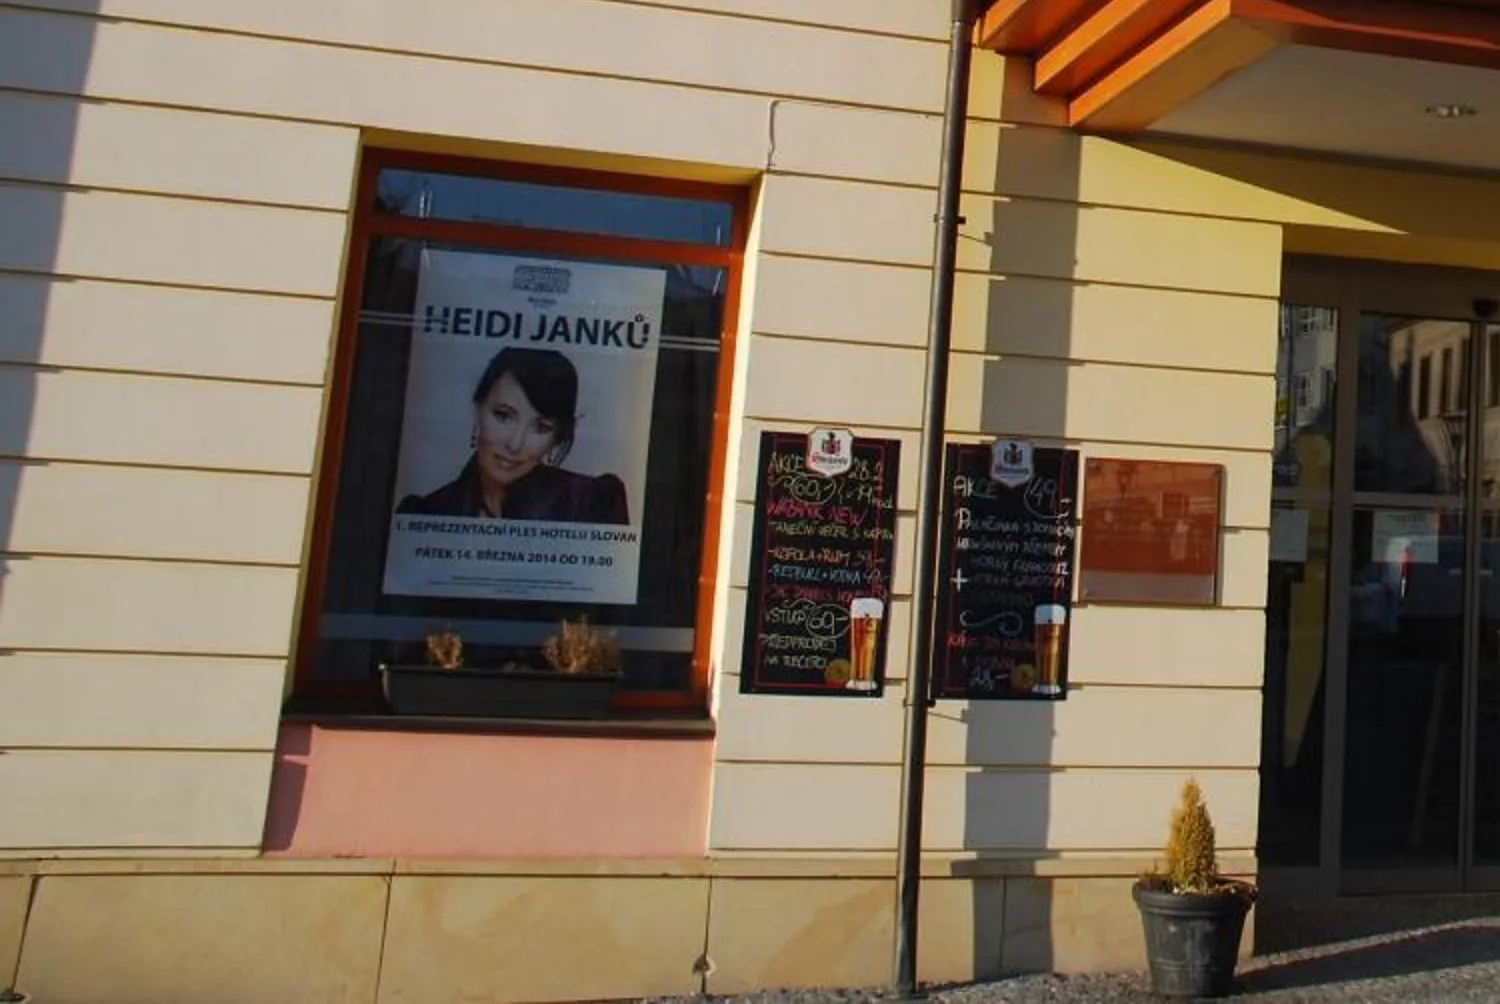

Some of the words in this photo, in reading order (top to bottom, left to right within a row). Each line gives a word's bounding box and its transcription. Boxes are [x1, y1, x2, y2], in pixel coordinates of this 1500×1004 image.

[423, 305, 523, 340] HEIDI
[529, 313, 650, 350] JANKŮ
[408, 520, 507, 537] REPREZENTAČNÍ
[509, 526, 537, 538] PLES
[540, 527, 587, 540] HOTELU
[590, 529, 637, 542] SLOVAN
[415, 545, 453, 559] PÁTEK
[476, 547, 525, 563] BŘEZNA
[560, 553, 578, 565] OD
